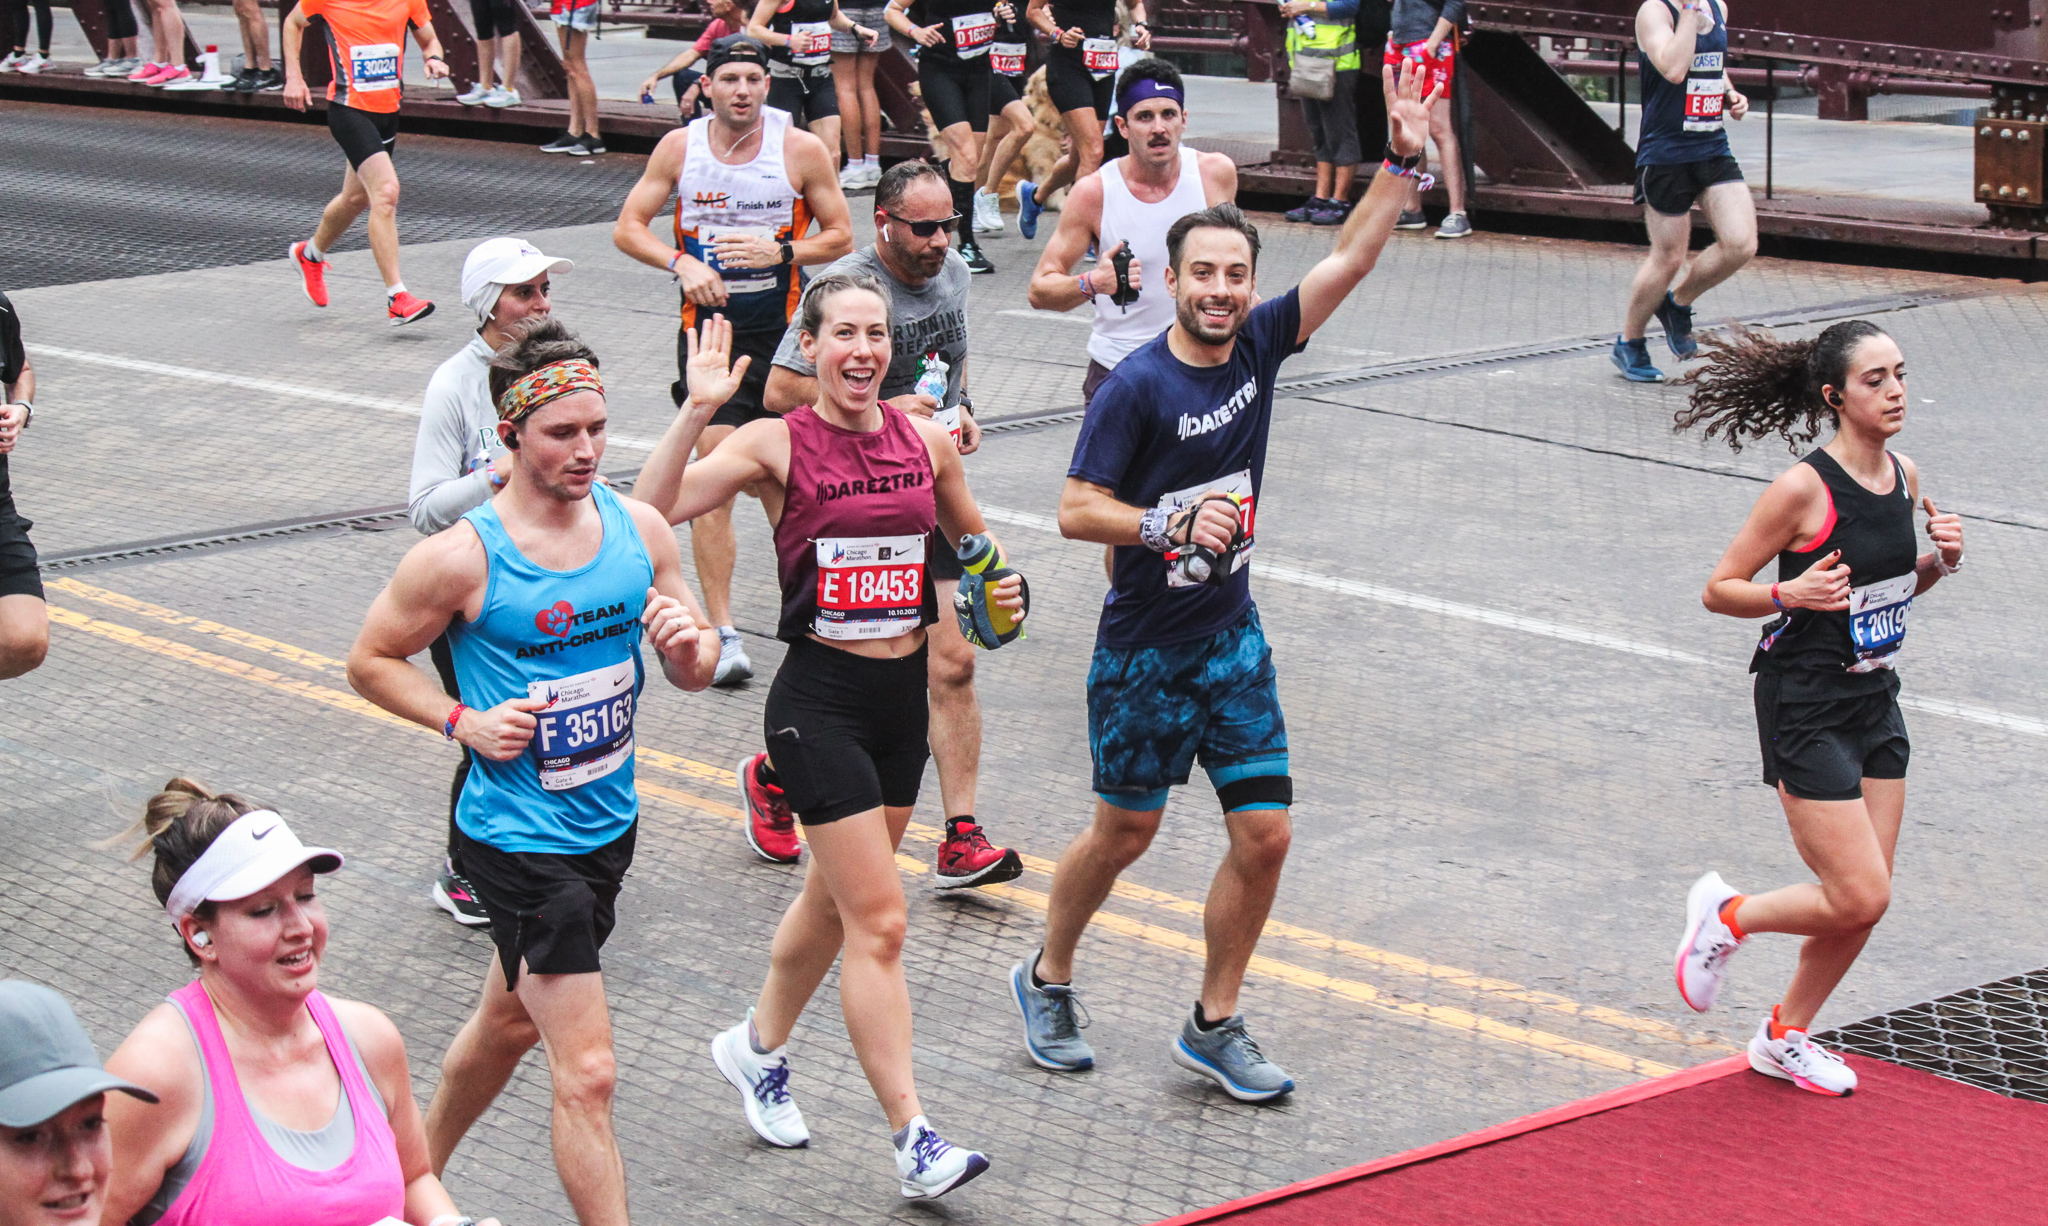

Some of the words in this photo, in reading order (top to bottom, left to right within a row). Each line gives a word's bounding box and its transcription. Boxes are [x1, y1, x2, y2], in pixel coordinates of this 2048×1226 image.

[957, 30, 965, 45] D
[353, 61, 362, 76] F
[364, 58, 396, 75] 30024
[1084, 51, 1094, 66] E
[1694, 54, 1721, 68] CASEY
[1692, 96, 1701, 114] E
[736, 201, 765, 210] Finish
[767, 200, 782, 209] MS
[893, 309, 964, 341] RUNNING
[894, 325, 967, 356] REFUGEES
[823, 572, 840, 603] E
[846, 568, 919, 603] 18453
[569, 602, 625, 626] TEAM
[821, 609, 845, 617] CHICAGO
[888, 608, 917, 616] 10.10.2021
[515, 616, 641, 660] ANTI-CRUELTY
[1853, 616, 1864, 646] F
[560, 687, 585, 697] Chicago
[561, 692, 591, 703] Marathon
[540, 717, 558, 752] F
[565, 693, 633, 748] 35163
[543, 756, 571, 766] CHICAGO
